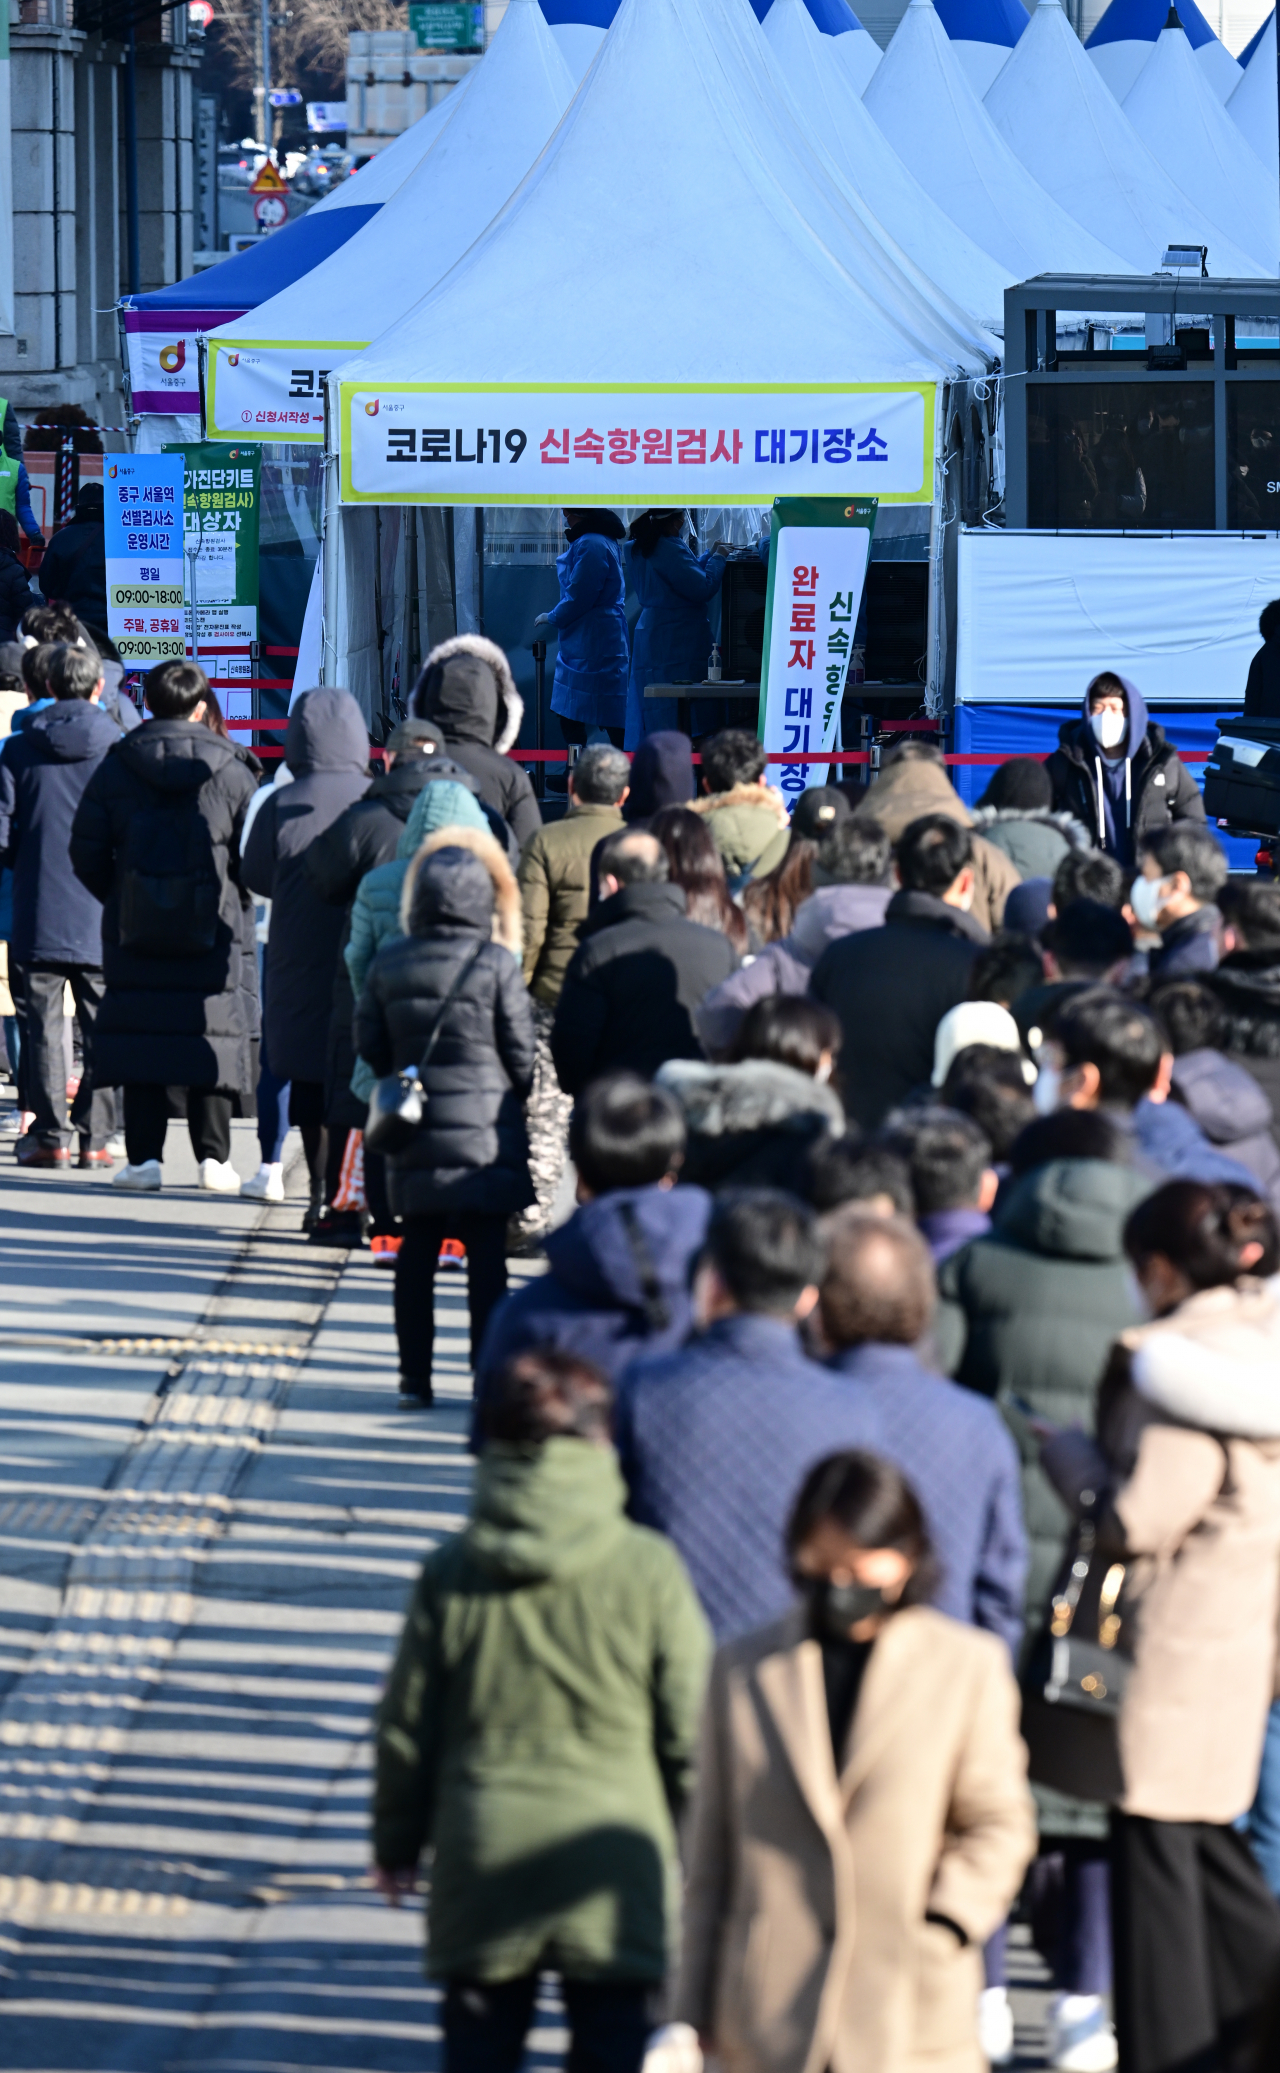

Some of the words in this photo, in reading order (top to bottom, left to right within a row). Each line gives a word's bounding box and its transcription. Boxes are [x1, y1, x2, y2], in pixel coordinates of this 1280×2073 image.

[160, 377, 186, 387] 서울중구
[382, 404, 405, 412] 서울중구
[255, 410, 310, 424] 신청서작성
[386, 428, 528, 464] 코로나19
[539, 428, 743, 464] 신속항원검사
[754, 427, 889, 464] 대기장소
[118, 485, 140, 503] 중구
[142, 485, 175, 504] 서울역
[121, 509, 175, 527] 선별검사소
[183, 511, 242, 531] 대상자
[127, 532, 170, 550] 운영시간
[139, 567, 160, 581] 평일
[115, 589, 183, 604] 09:00~18:00
[787, 565, 820, 670] 완료자
[123, 618, 147, 634] 주말,
[149, 618, 180, 633] 공휴일
[117, 641, 184, 656] 09:00~13:00
